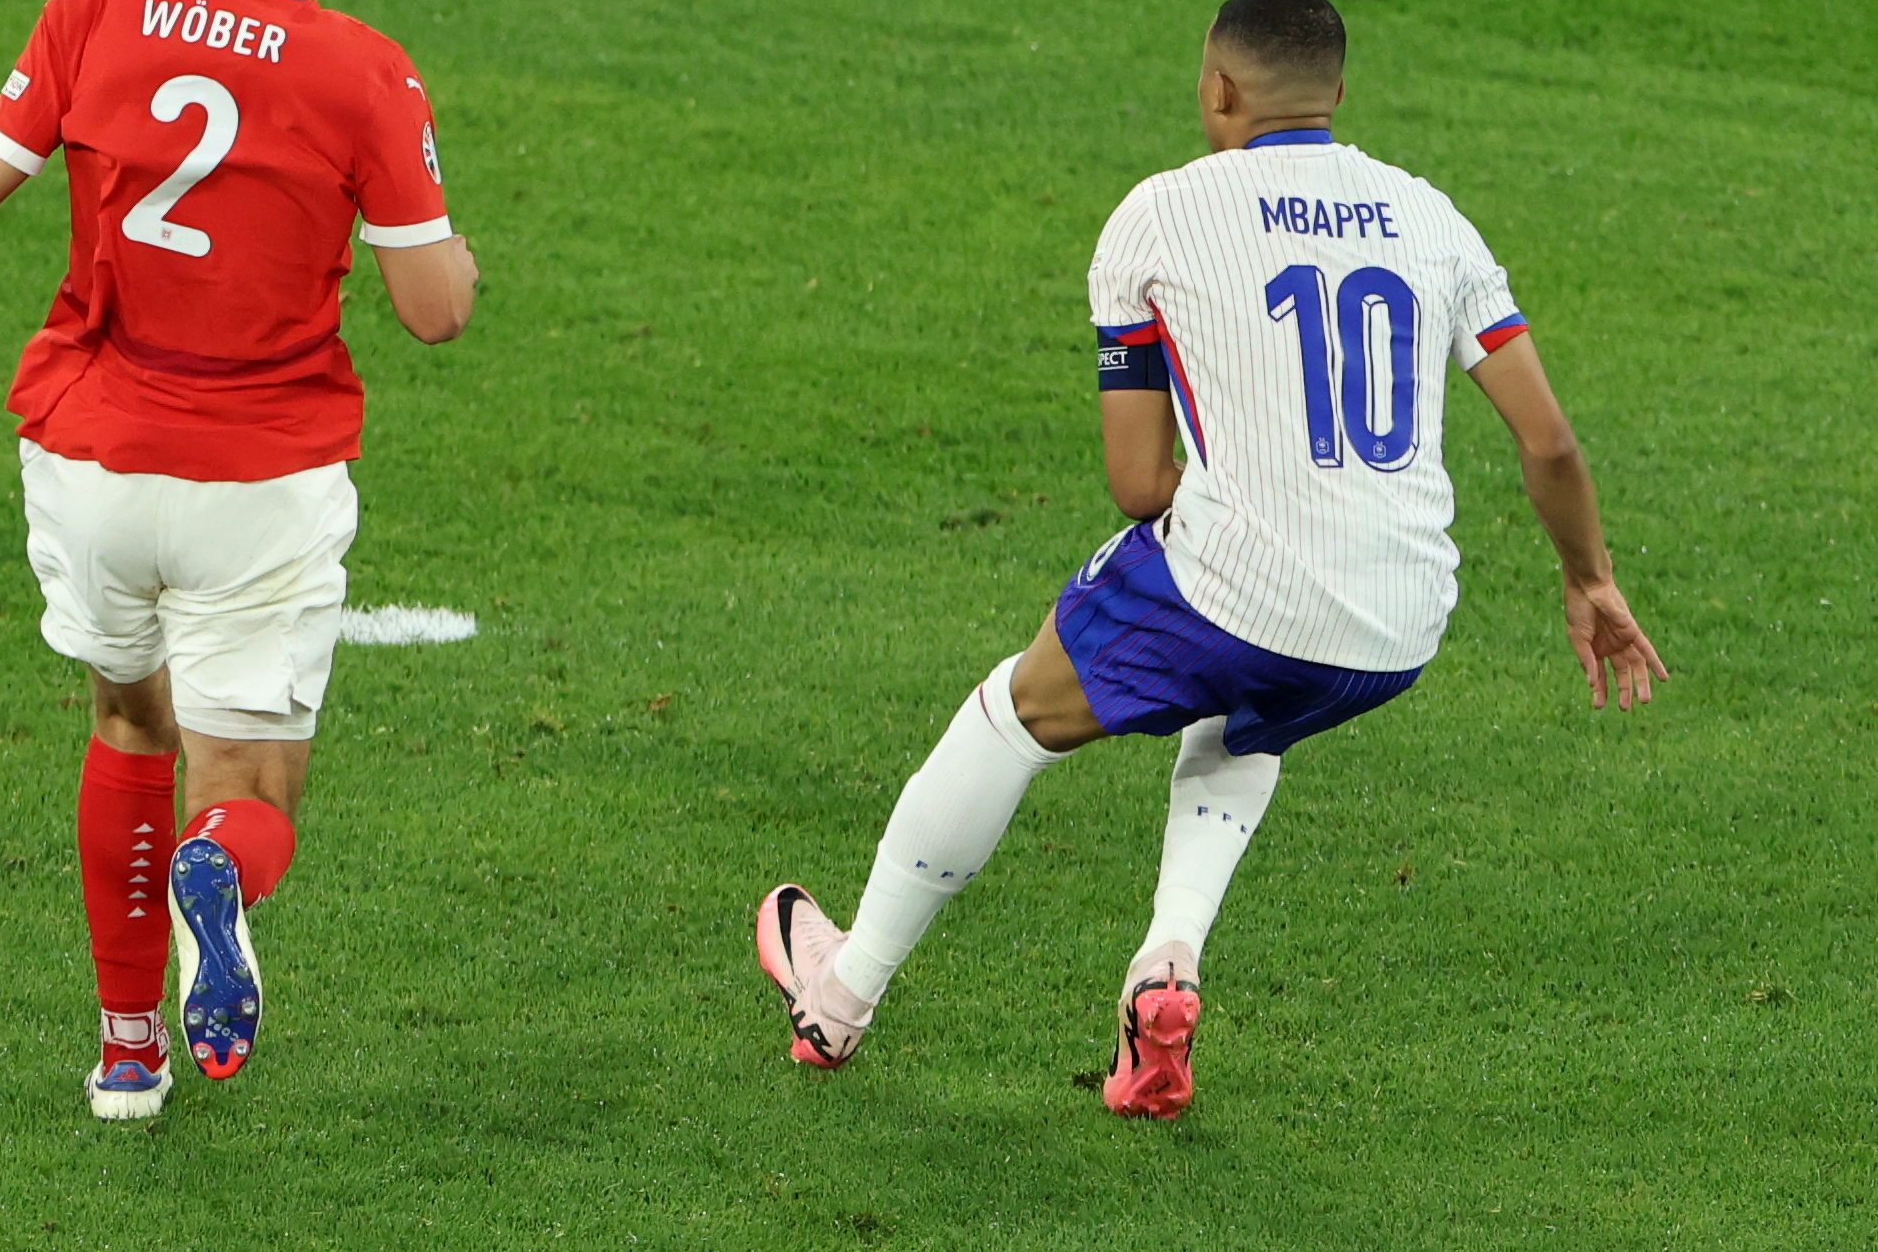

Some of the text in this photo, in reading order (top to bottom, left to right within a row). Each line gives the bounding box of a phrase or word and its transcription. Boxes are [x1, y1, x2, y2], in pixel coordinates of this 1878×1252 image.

[121, 74, 239, 258] 2
[1258, 196, 1400, 239] MBAPPE
[1264, 264, 1421, 473] 10
